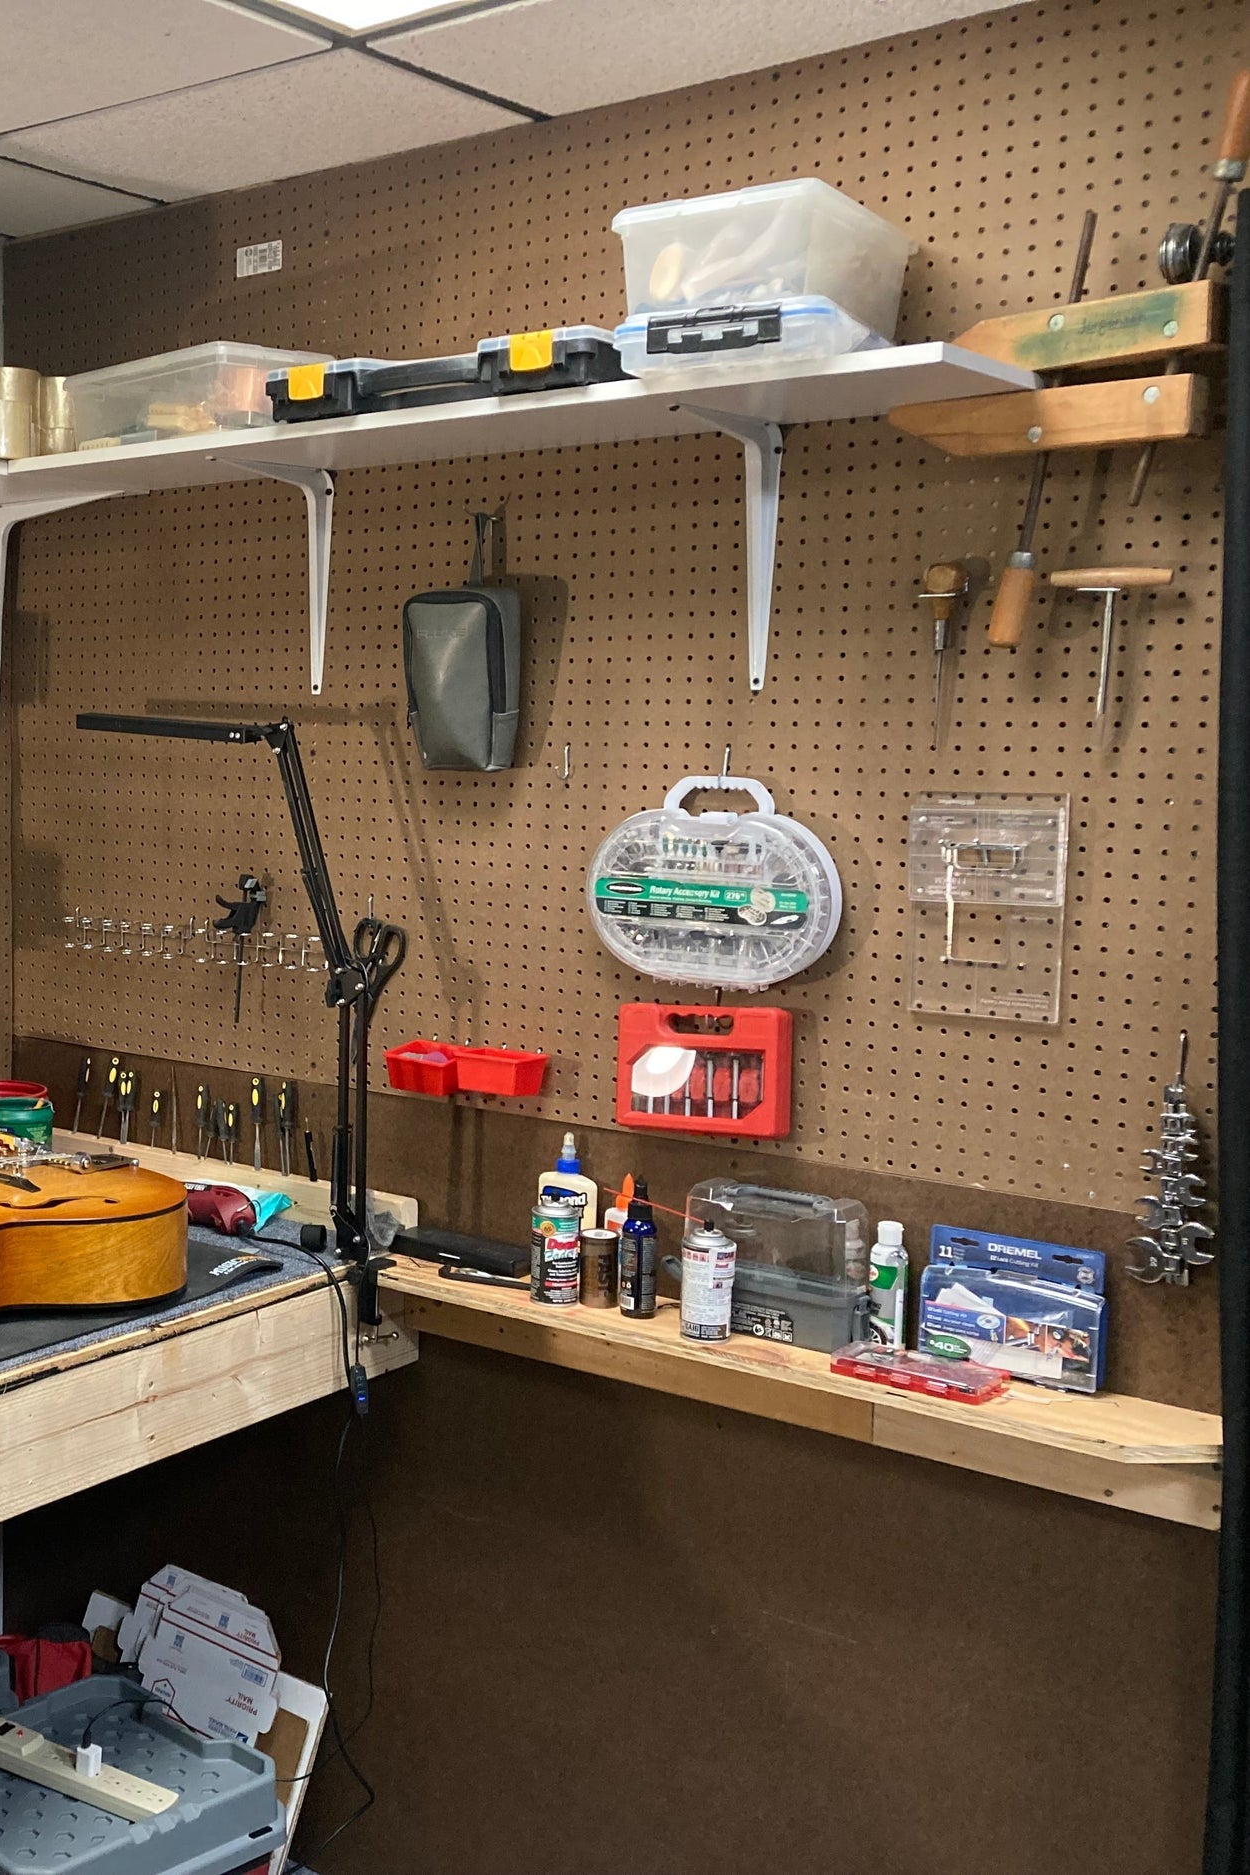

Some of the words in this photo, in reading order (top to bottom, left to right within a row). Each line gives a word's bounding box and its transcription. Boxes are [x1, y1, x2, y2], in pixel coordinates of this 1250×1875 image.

[650, 886, 672, 896] Rotary
[673, 888, 710, 903] Accessory
[710, 890, 720, 898] Kit
[938, 1245, 953, 1258] 11
[987, 1243, 1042, 1260] DREMEL
[225, 1696, 258, 1717] PRIORITY
[237, 1691, 254, 1705] MAIL
